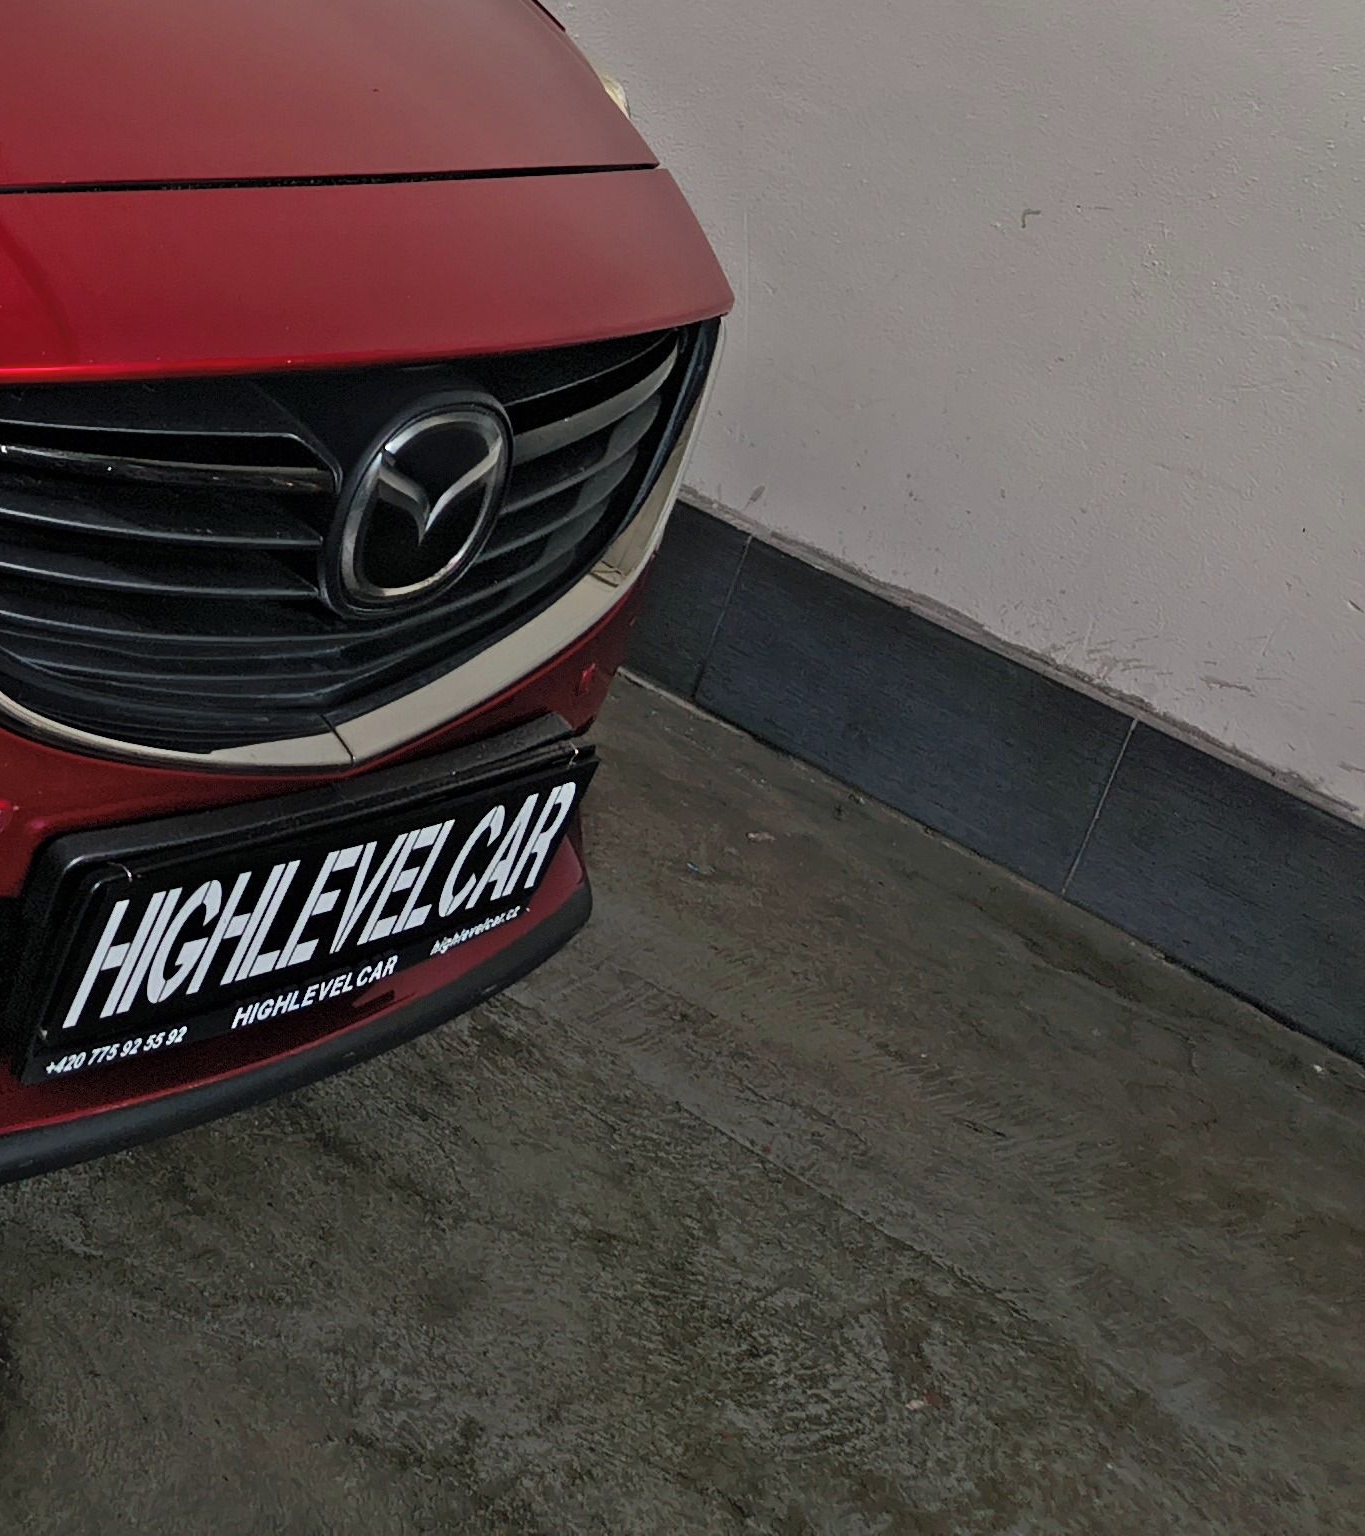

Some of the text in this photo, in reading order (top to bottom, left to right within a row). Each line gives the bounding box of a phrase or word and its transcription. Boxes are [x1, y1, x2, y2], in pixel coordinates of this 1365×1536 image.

[62, 781, 577, 1029] HIGHLEVEL CAR
[230, 954, 400, 1030] HIGHLEVEL CAR
[45, 1025, 188, 1074] +420 775 92 55 92
